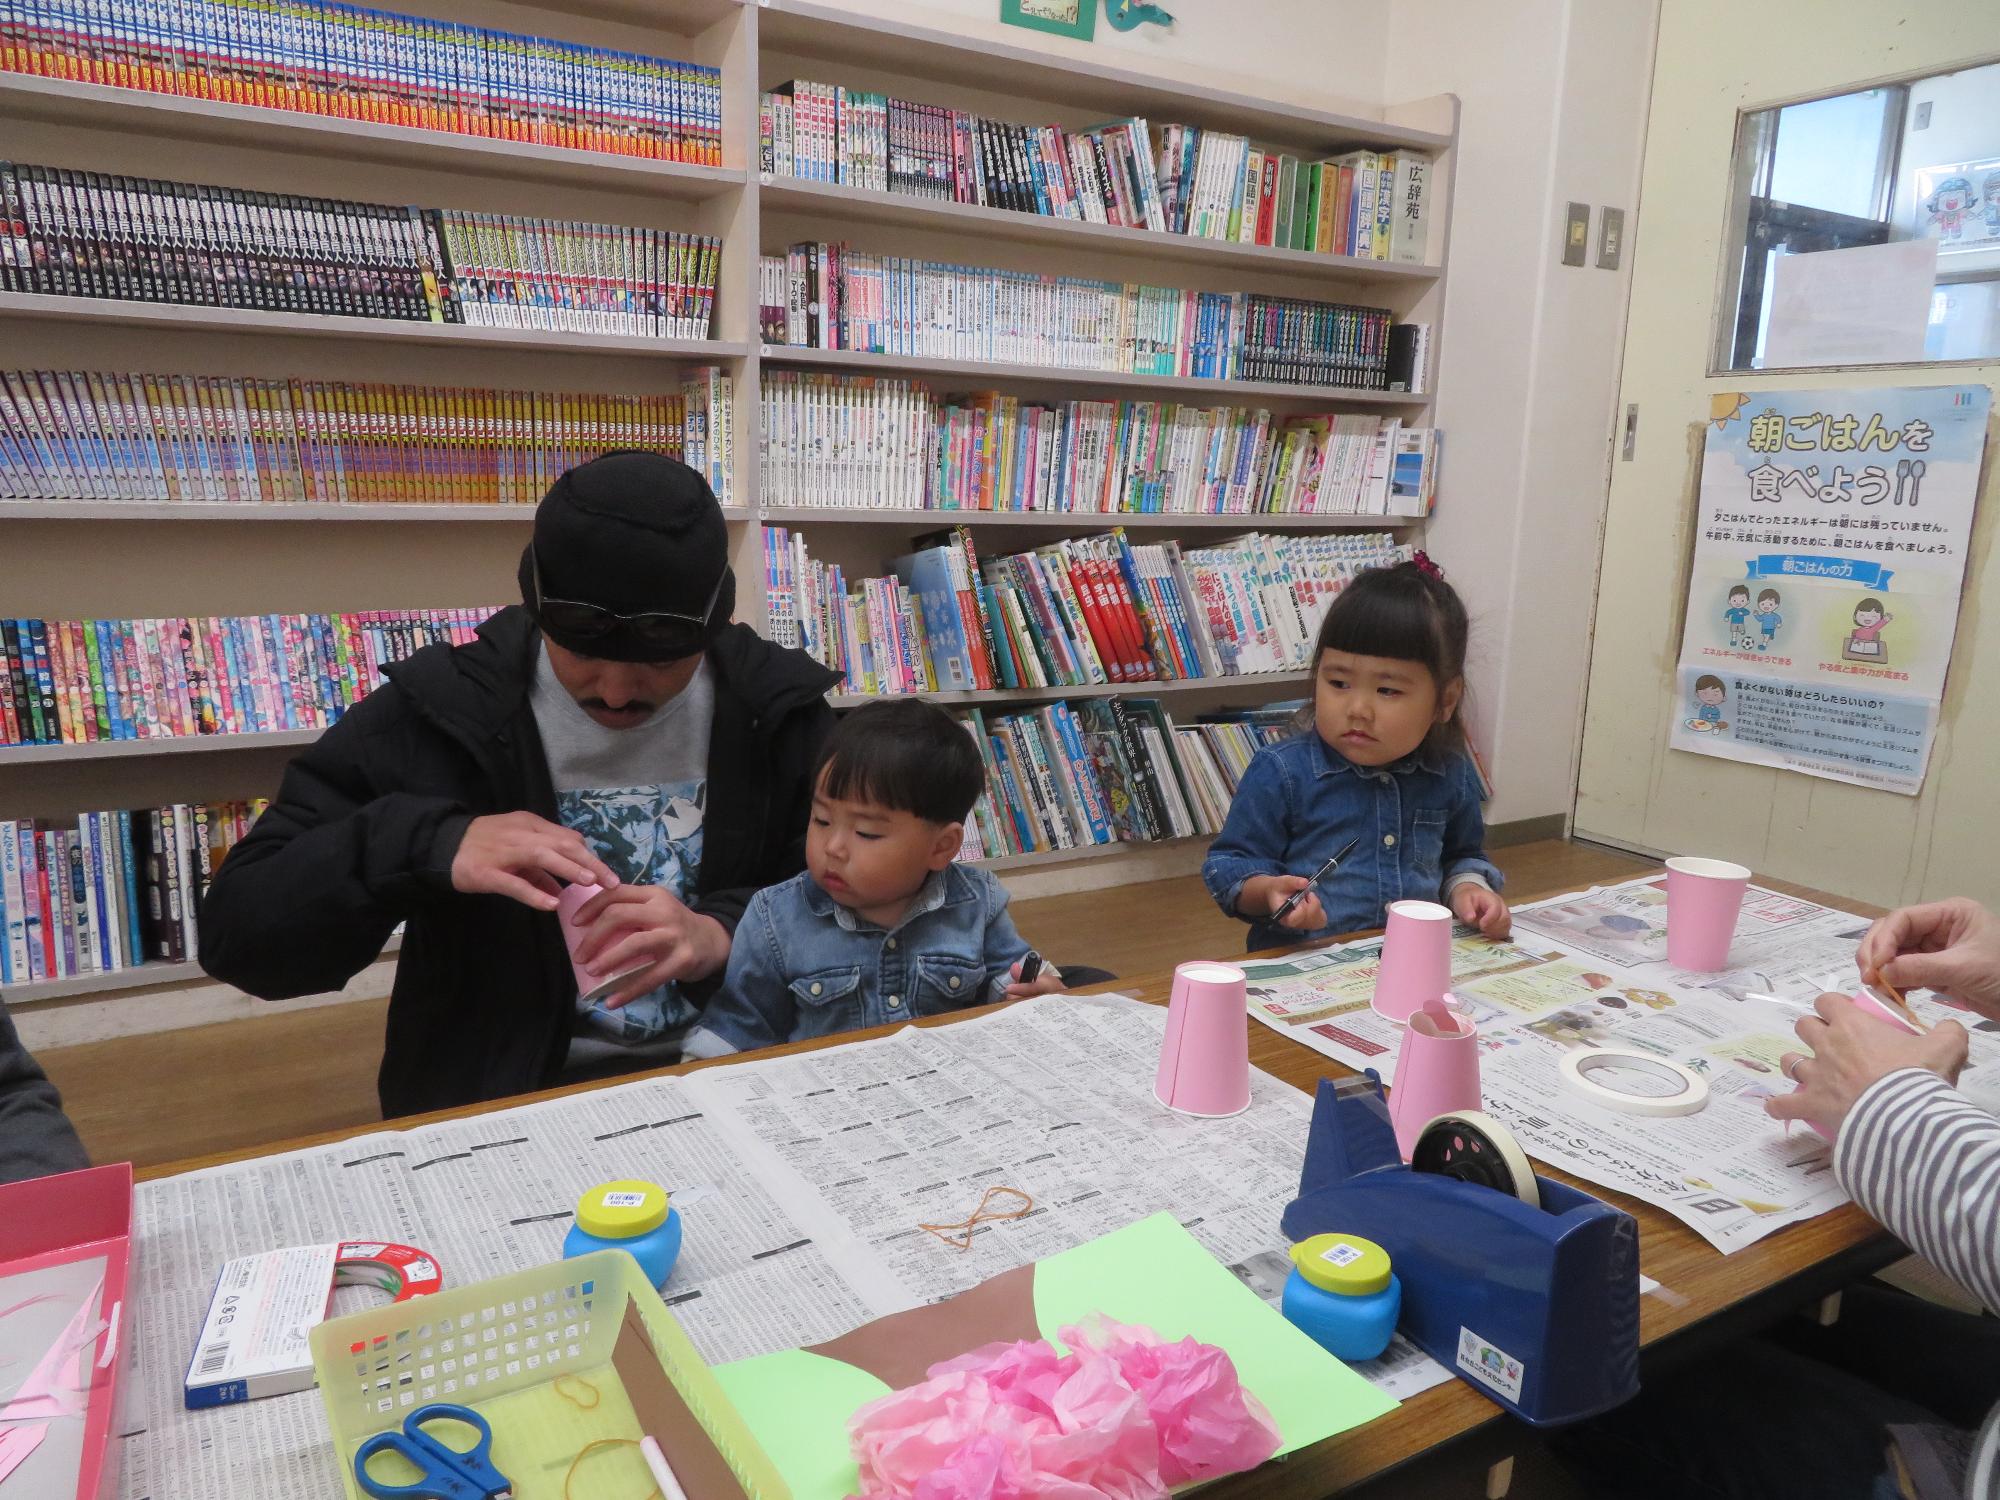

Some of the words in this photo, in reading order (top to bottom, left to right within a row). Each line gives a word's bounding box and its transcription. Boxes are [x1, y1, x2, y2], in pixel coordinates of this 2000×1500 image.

[1405, 166, 1424, 220] 広辞苑
[1747, 413, 1934, 453] 朝ごはんを
[1747, 464, 1890, 502] 食べよう
[1781, 559, 1854, 578] 朝ごはんの力
